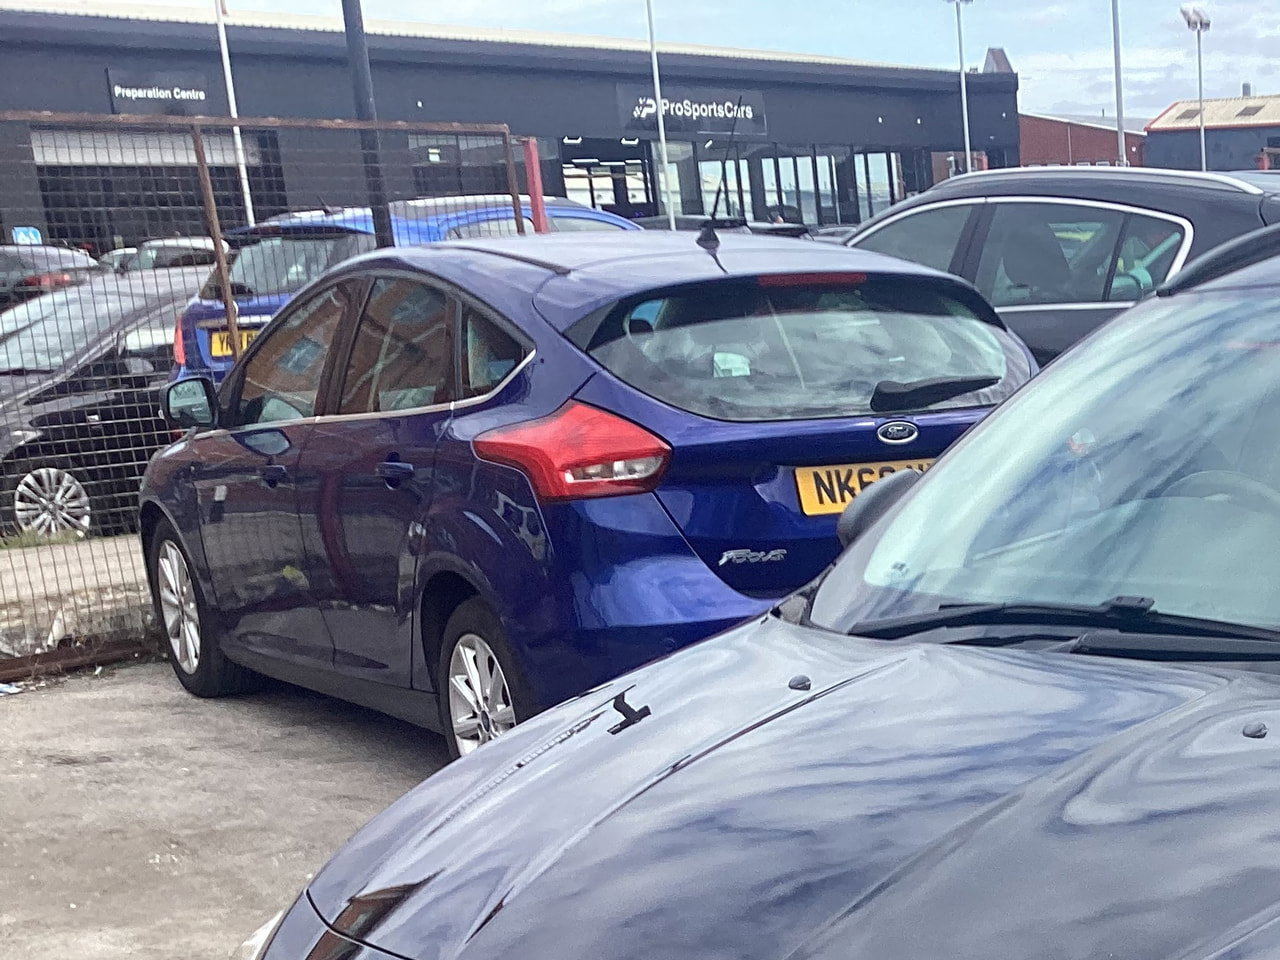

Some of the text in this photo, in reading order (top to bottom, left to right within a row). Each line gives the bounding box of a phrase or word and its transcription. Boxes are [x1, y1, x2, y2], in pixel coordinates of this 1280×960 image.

[114, 85, 205, 100] Preparation Centre
[661, 98, 753, 119] ProSportsCars
